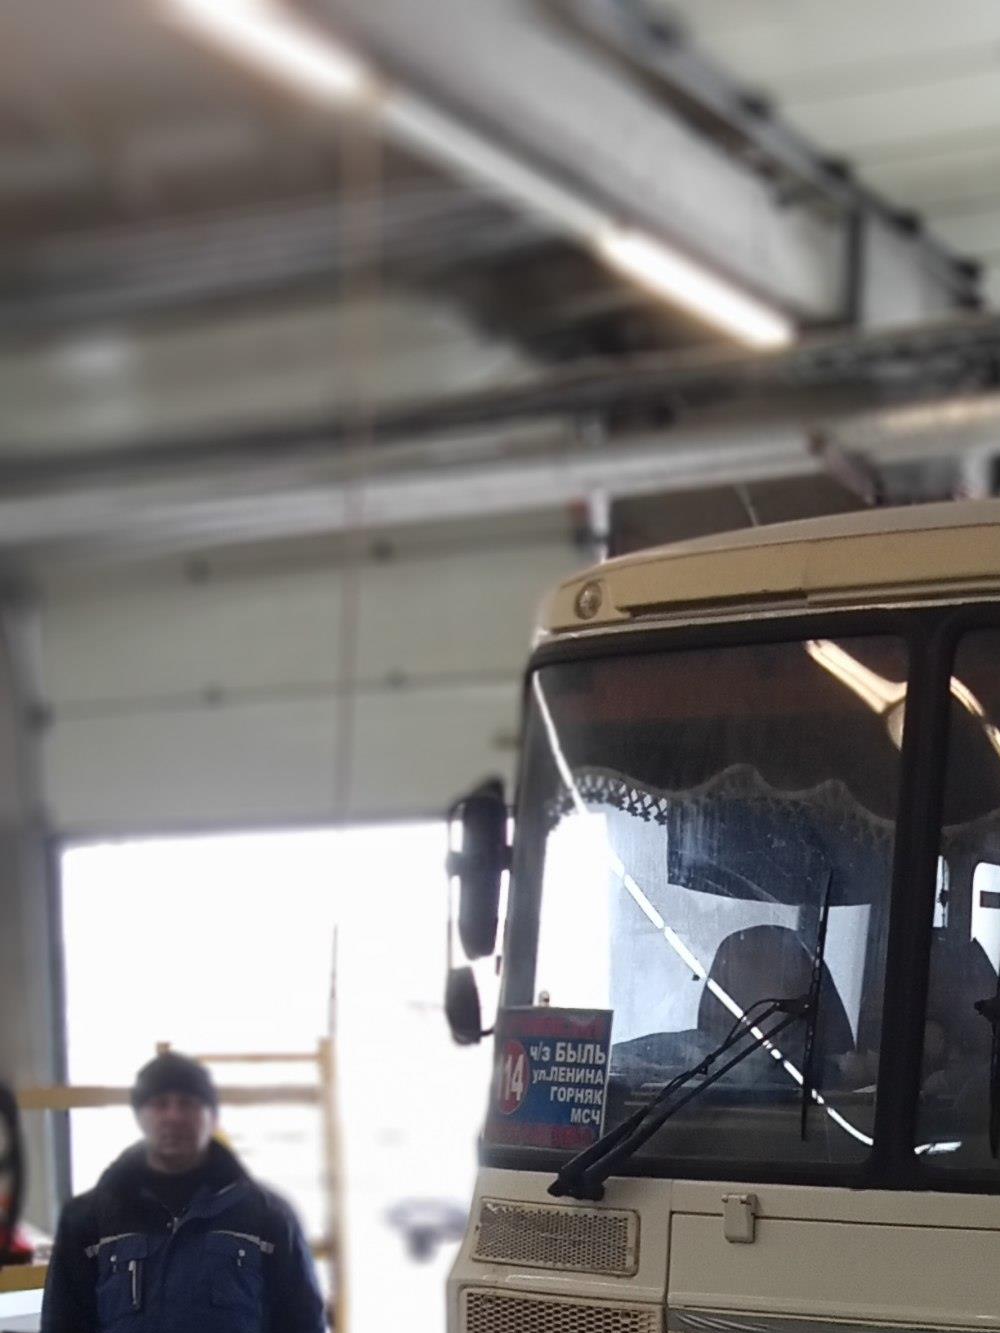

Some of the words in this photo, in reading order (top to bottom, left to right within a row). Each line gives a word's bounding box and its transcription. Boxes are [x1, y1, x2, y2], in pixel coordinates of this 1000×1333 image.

[555, 1042, 606, 1064] БЫЛЬ
[550, 1086, 603, 1105] ГОРНЯК
[570, 1108, 600, 1125] МСЧ
